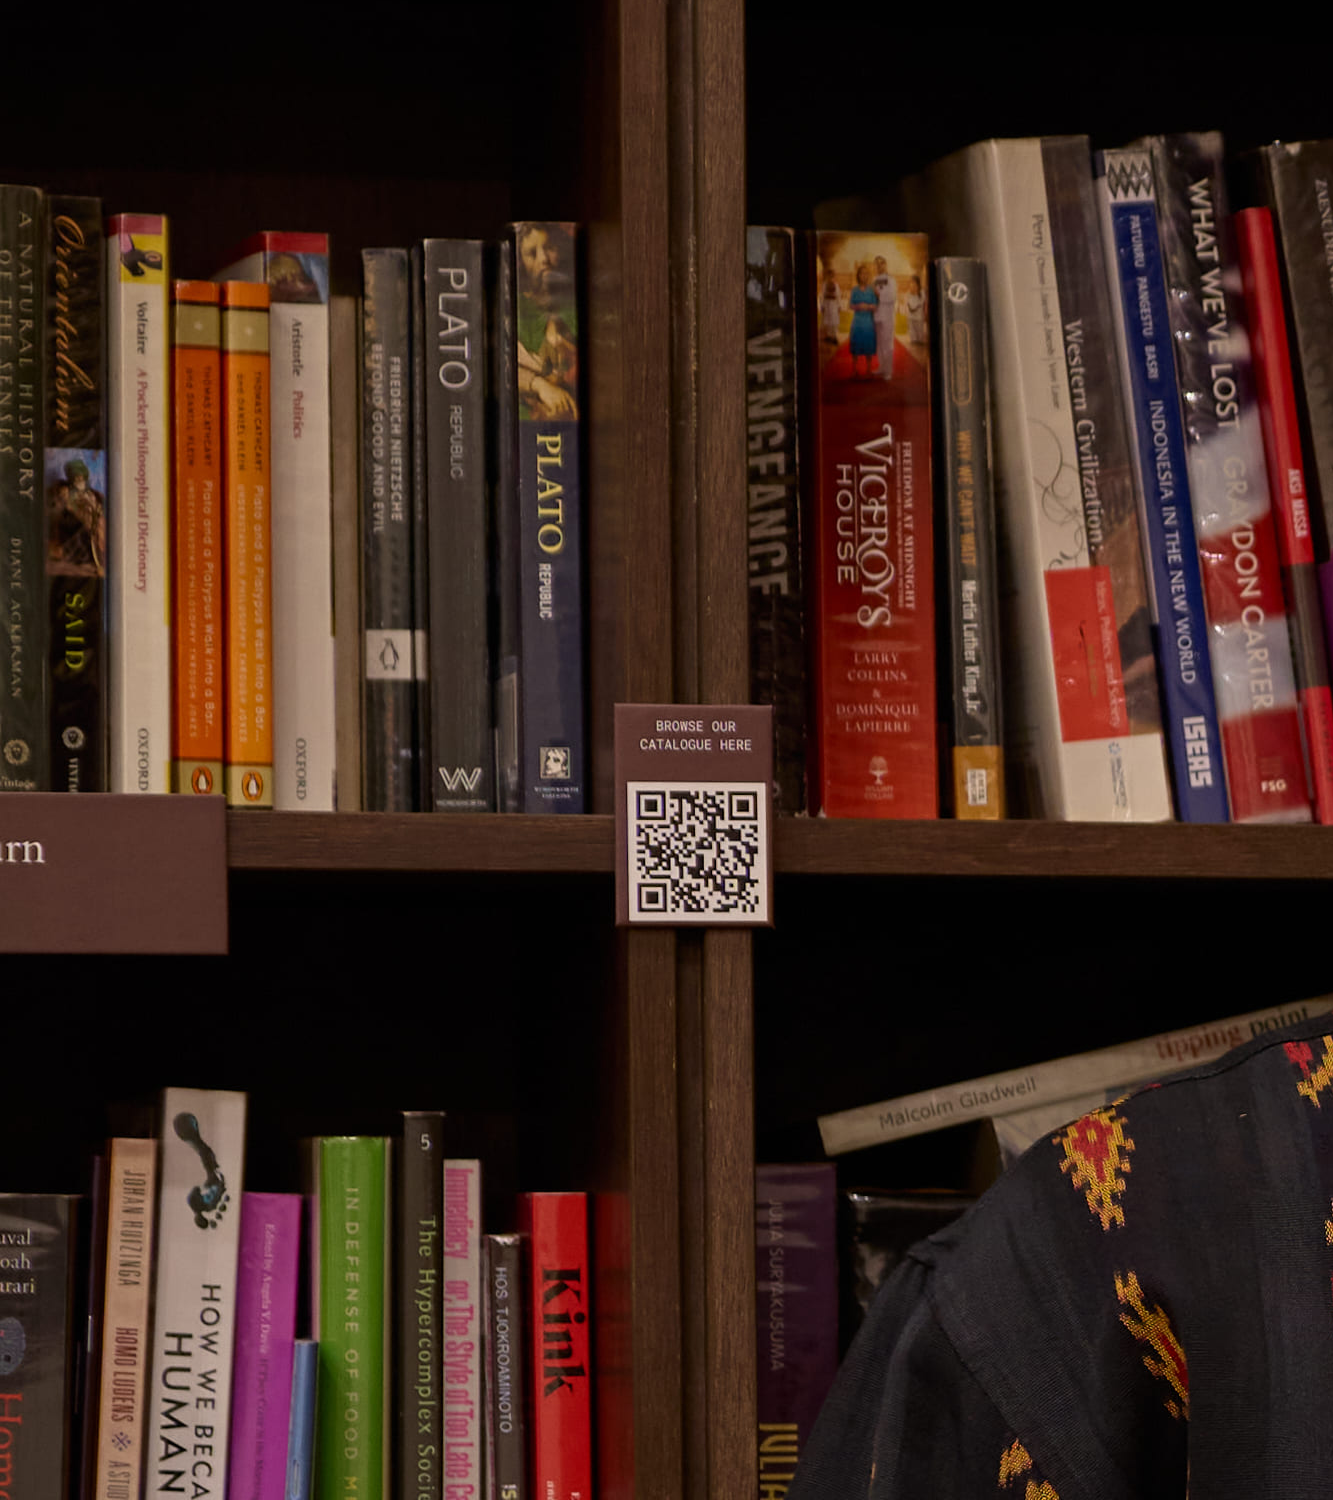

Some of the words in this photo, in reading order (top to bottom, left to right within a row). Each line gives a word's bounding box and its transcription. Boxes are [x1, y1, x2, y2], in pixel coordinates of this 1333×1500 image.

[136, 302, 148, 353] Voltaire
[438, 267, 470, 389] PLATO
[449, 405, 464, 478] REPUBLIC
[1148, 400, 1176, 500] INDONESIA
[536, 432, 563, 552] PLATO
[836, 463, 853, 584] HOUSE
[854, 423, 896, 628] VICEROY'S
[1163, 506, 1179, 523] IN
[1165, 530, 1184, 564] THE
[537, 563, 552, 619] REPUBLIC
[1168, 570, 1190, 612] NEW
[63, 593, 86, 669] SAID
[1174, 617, 1196, 683] WORLD
[640, 738, 712, 751] CATALOGUE
[720, 739, 752, 751] HERE
[656, 720, 703, 732] BROWSE
[711, 720, 736, 732] OUR
[1183, 716, 1212, 787] ISEAS
[878, 1100, 953, 1131] Malcolm
[959, 1077, 1037, 1109] Gladwell
[200, 1283, 221, 1355] HOW
[541, 1267, 585, 1397] Kink
[158, 1332, 193, 1493] HUMAN
[196, 1367, 218, 1411] WE
